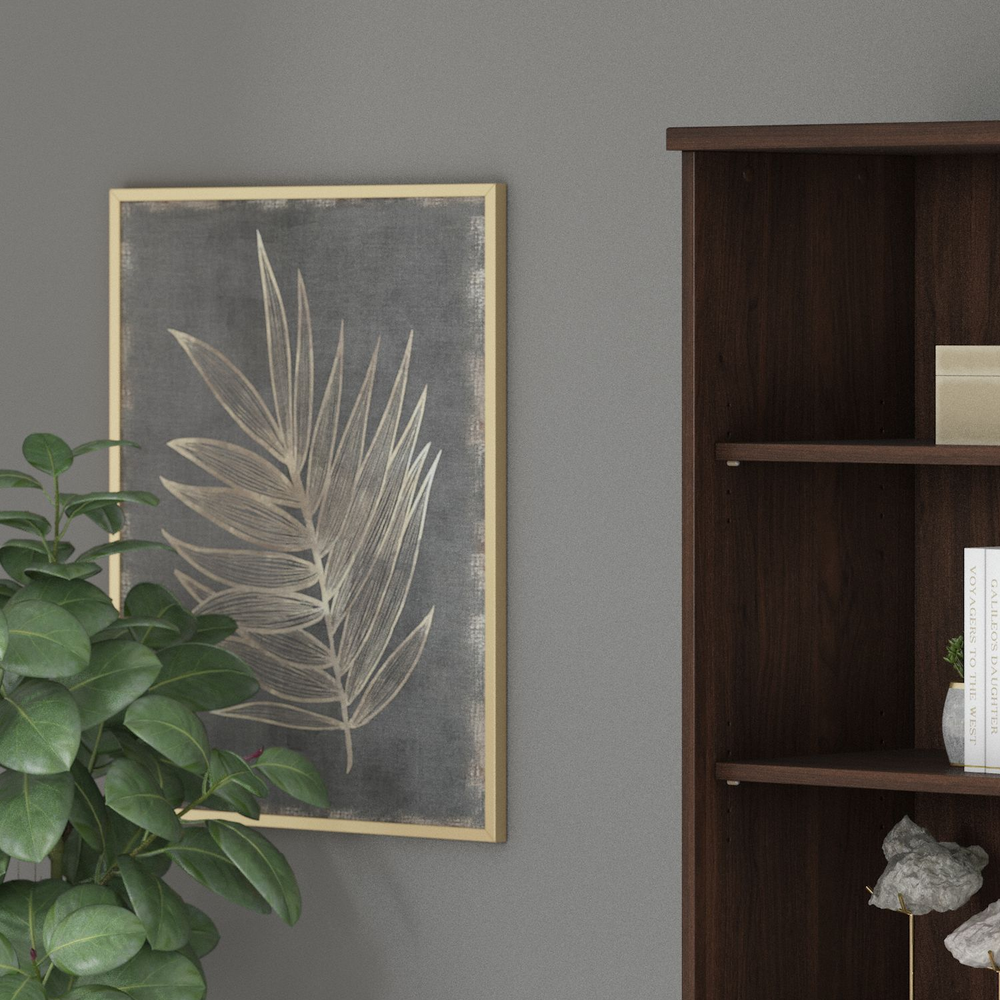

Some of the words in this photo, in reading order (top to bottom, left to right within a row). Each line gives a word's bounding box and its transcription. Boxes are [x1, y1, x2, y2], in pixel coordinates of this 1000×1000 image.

[969, 565, 977, 644] VOYAGERS
[990, 578, 999, 652] GALILEO'S
[969, 648, 977, 668] TO
[969, 675, 977, 701] THE
[990, 656, 999, 735] DAUGHTER
[969, 706, 977, 745] WEST
